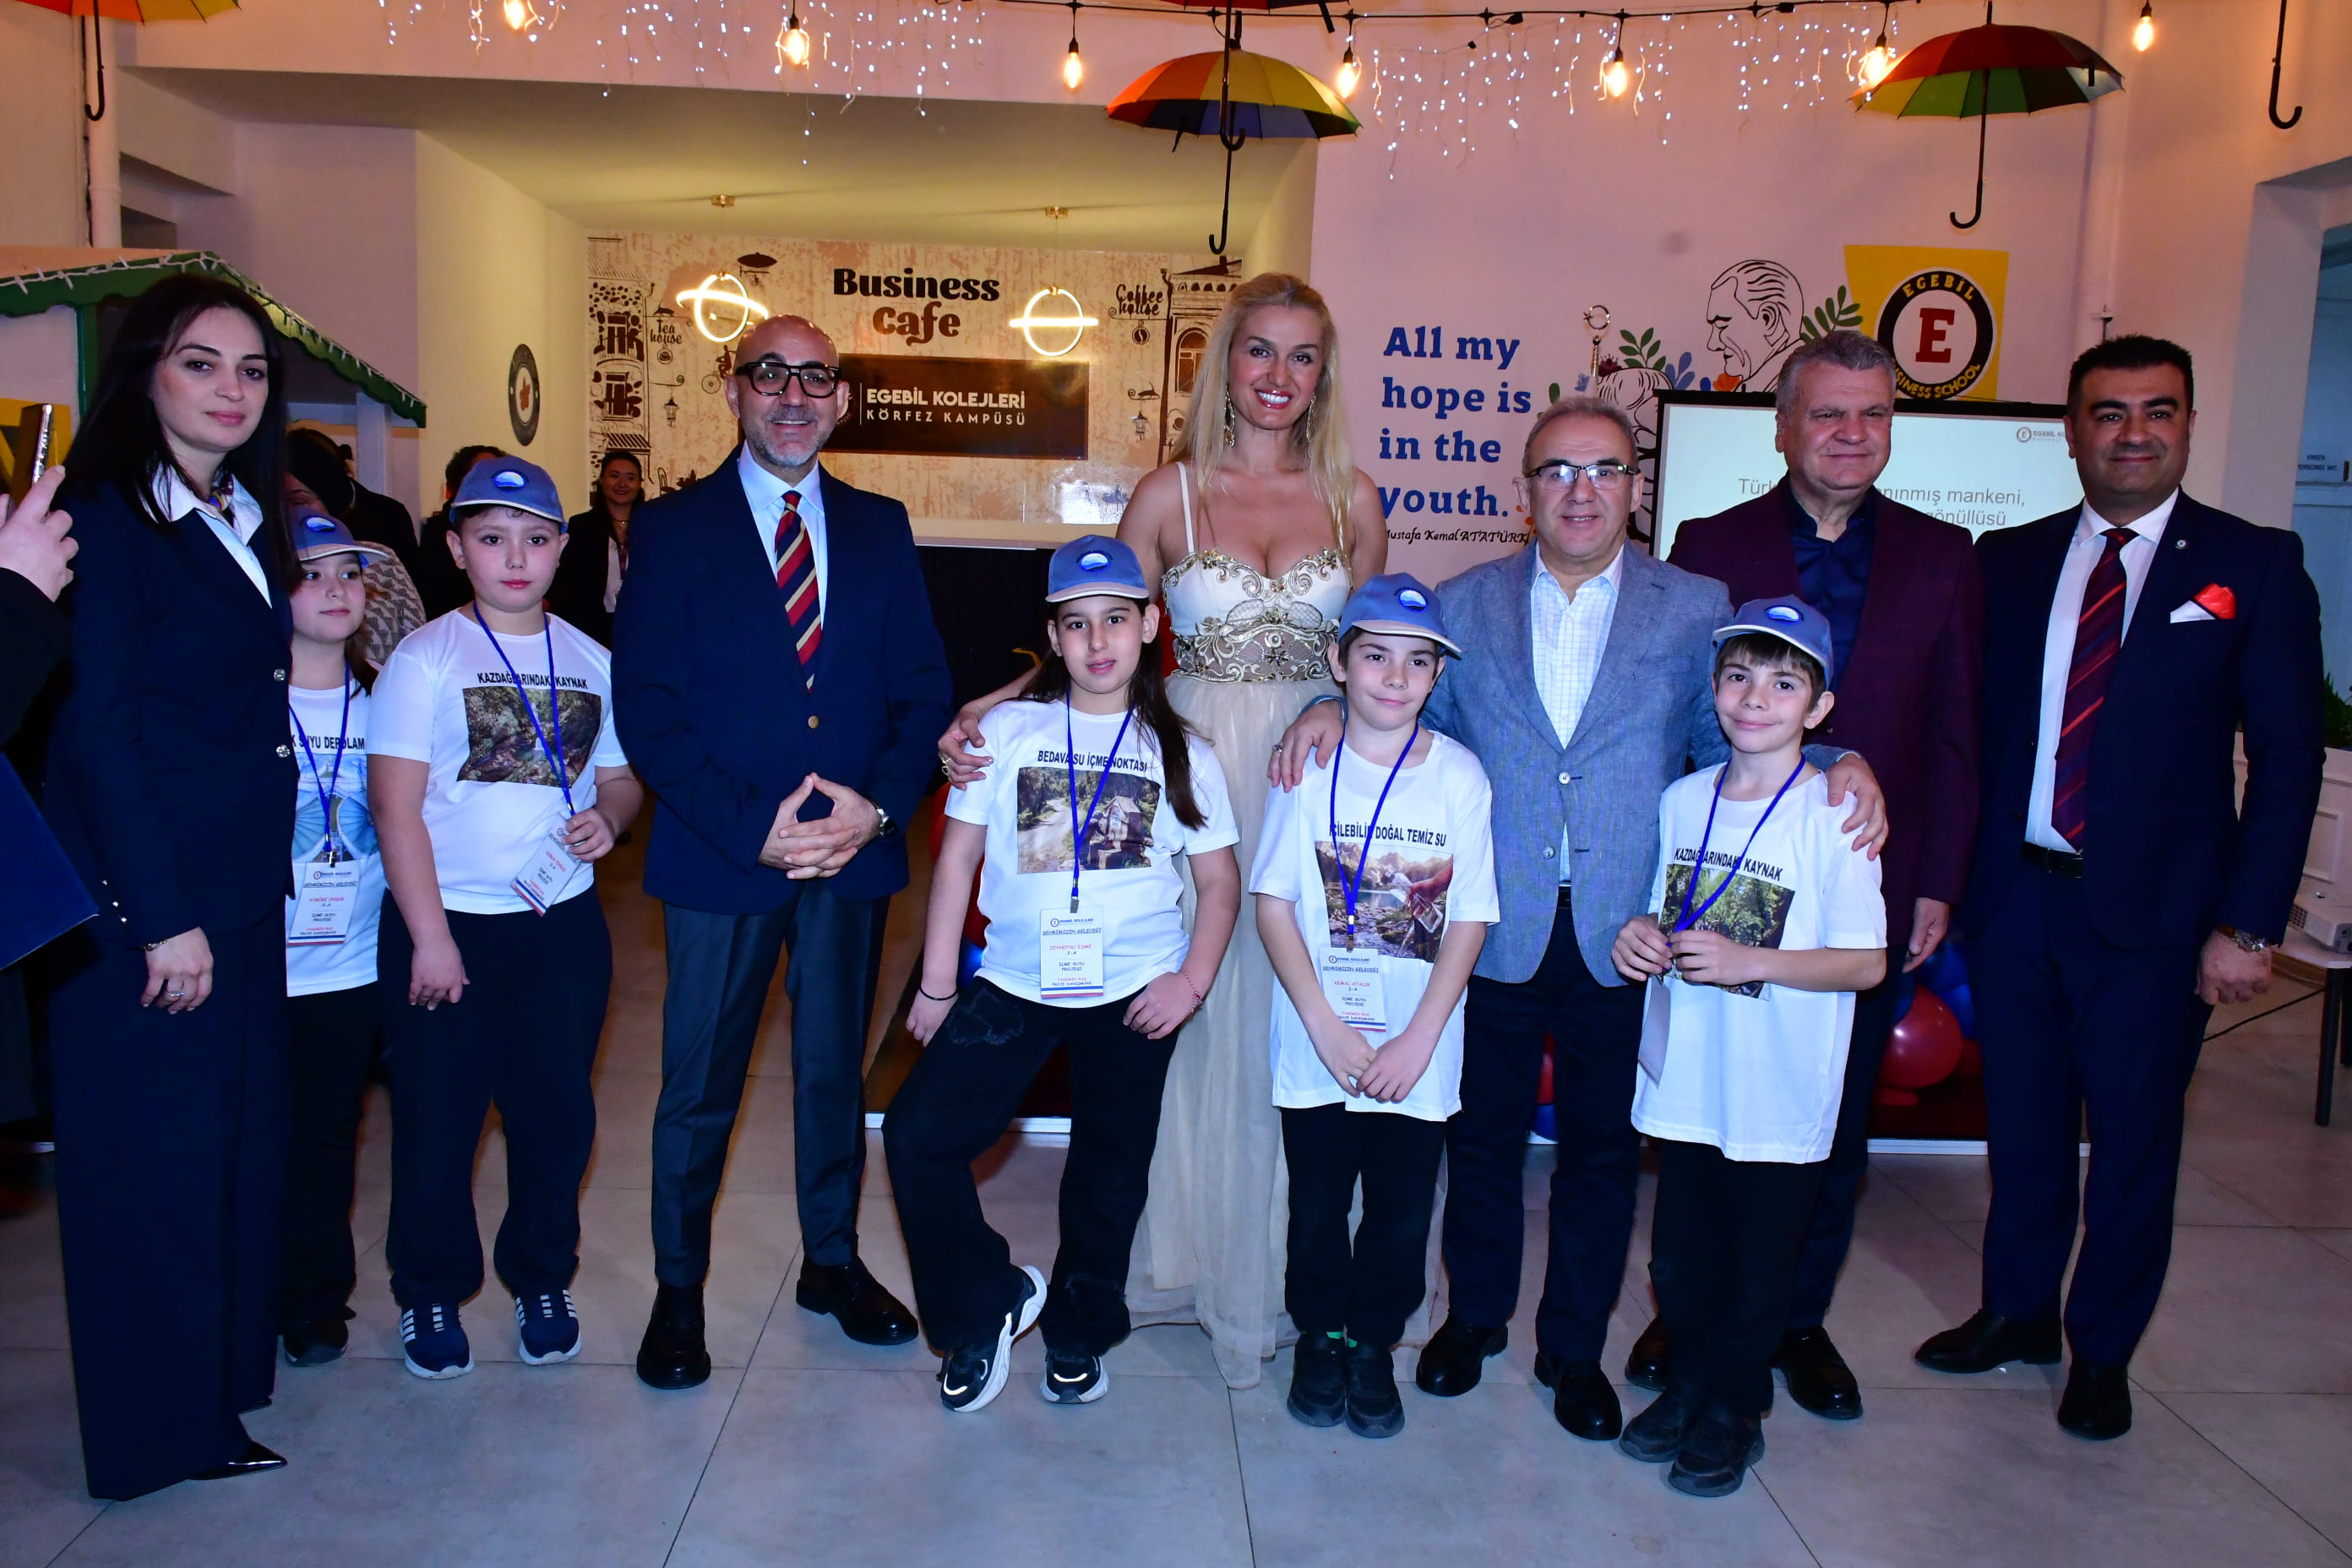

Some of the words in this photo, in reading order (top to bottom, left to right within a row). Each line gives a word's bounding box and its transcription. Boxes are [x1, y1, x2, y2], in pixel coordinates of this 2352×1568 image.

[834, 268, 1000, 301] Business
[1116, 284, 1163, 305] Coffee
[1903, 274, 1974, 301] EGEBİL
[1119, 298, 1159, 315] house
[656, 319, 675, 333] Tea
[872, 301, 961, 346] Cafe
[651, 329, 683, 344] house
[1915, 308, 1955, 363] E
[1383, 326, 1442, 358] All
[1456, 337, 1520, 370] my
[1895, 363, 1931, 399] SINESS
[1935, 365, 1980, 398] SCHOOL
[867, 387, 928, 406] EGEBİL
[933, 389, 1026, 409] KOLEJLERİ
[1382, 377, 1484, 419] hope
[1497, 381, 1532, 413] is
[867, 407, 933, 422] KÖRFEZ
[944, 411, 1026, 426] KAMPÜSÜ
[1380, 427, 1421, 460] in
[1435, 430, 1501, 463] the
[1377, 486, 1508, 520] youth.
[1947, 488, 2024, 508] mankeni,
[1424, 528, 1461, 542] Kemal
[1460, 530, 1530, 547] ATATÜRK
[555, 676, 588, 689] KAYNAK
[1073, 754, 1085, 765] SU
[1087, 751, 1108, 769] İÇME
[1111, 757, 1147, 772] NOKTASI
[1375, 824, 1404, 841] DOĞAL
[1407, 828, 1434, 845] TEMİZ
[1435, 832, 1446, 847] SU
[1744, 858, 1783, 881] KAYNAK
